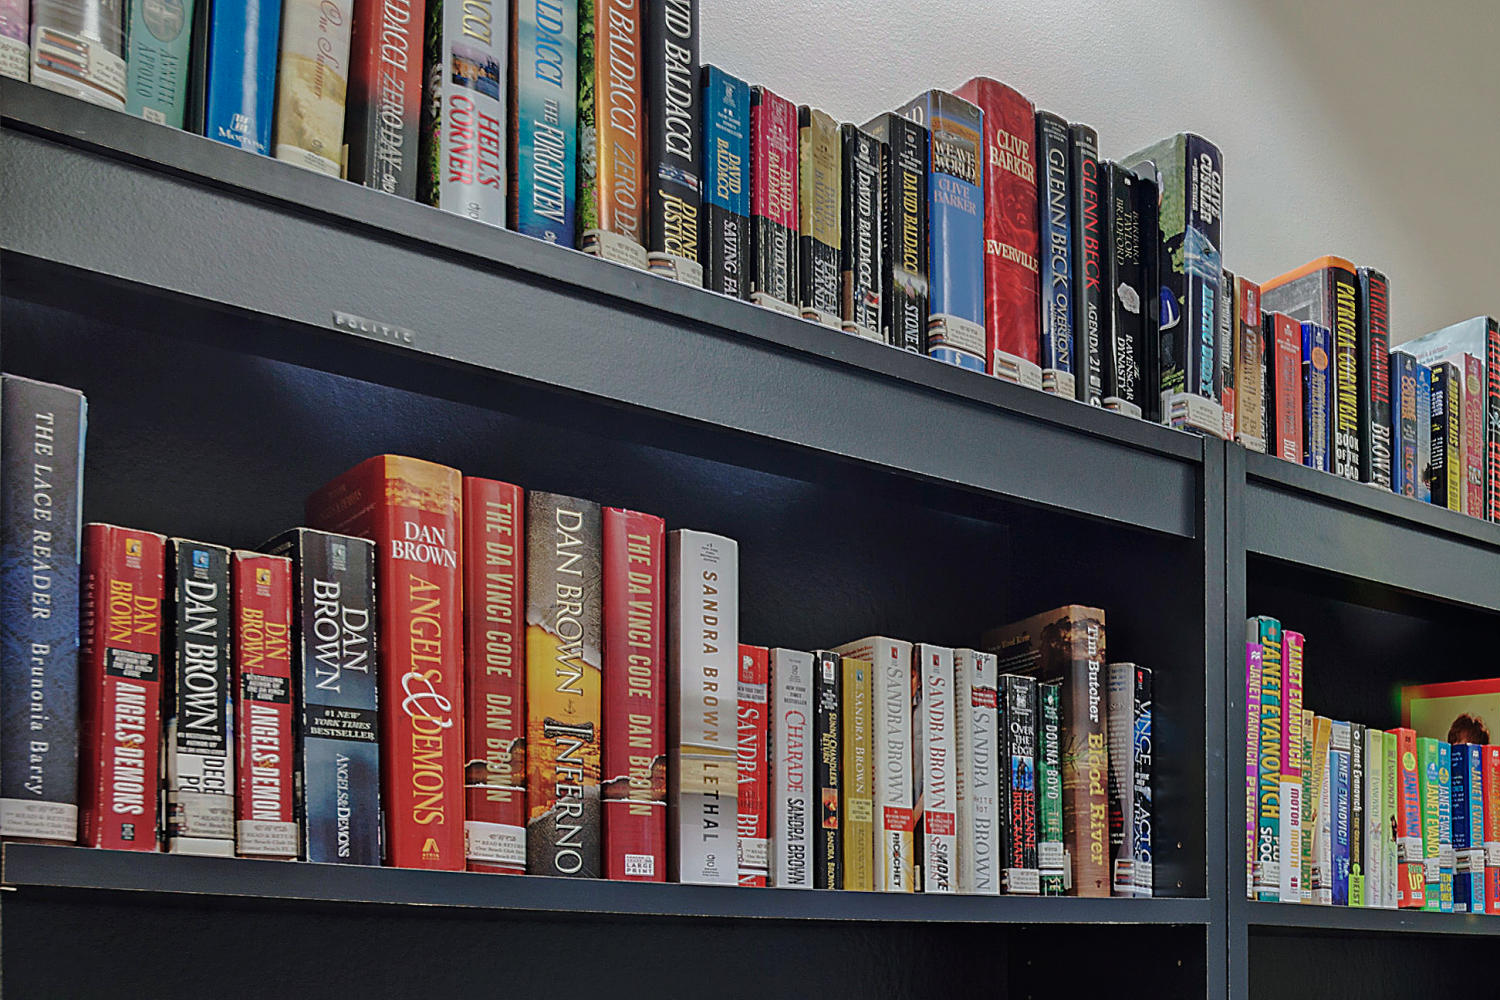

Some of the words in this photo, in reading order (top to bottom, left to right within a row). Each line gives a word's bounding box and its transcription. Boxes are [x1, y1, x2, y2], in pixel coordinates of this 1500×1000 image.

[608, 21, 636, 139] BALDACCI
[664, 39, 692, 161] BALDACCI
[448, 95, 474, 185] CORNER
[477, 111, 500, 190] HELL'S
[717, 138, 729, 200] BALDACCI
[989, 146, 1035, 184] BARKER
[996, 128, 1030, 157] CLIVE
[533, 120, 565, 225] FORGOTTEN
[613, 144, 637, 208] ZERO
[1049, 150, 1066, 228] GLENN
[1081, 159, 1100, 232] GLENN
[858, 220, 872, 294] BALDACCI
[986, 239, 1039, 275] EVERVILLE
[1051, 231, 1068, 289] BECK
[1084, 233, 1101, 291] BECK
[1337, 281, 1356, 352] PATRICIA
[1370, 278, 1387, 337] PATRICIA
[1337, 353, 1358, 432] CORNWELL
[34, 412, 54, 458] THE
[1336, 432, 1359, 453] BOOK
[32, 465, 53, 521] LACE
[485, 501, 512, 536] THE
[391, 540, 457, 569] BROWN
[404, 521, 446, 546] DAN
[486, 543, 513, 571] DA
[555, 508, 584, 577] DAN
[627, 533, 652, 567] THE
[31, 527, 52, 621] READER
[486, 572, 512, 627] VINCI
[627, 571, 652, 598] DA
[110, 579, 132, 643] BROWN
[132, 595, 158, 637] DAN
[184, 579, 219, 634] DAN
[242, 607, 265, 670] BROWN
[313, 578, 342, 694] BROWN
[410, 574, 441, 685] ANGELS
[627, 599, 652, 653] VINCI
[702, 570, 718, 655] SANDRA
[265, 620, 287, 660] DAN
[341, 607, 369, 674] DAN
[486, 629, 512, 678] CODE
[555, 583, 584, 697] BROWN
[1262, 636, 1281, 700] JANET
[30, 643, 50, 732] Brunonia
[184, 640, 220, 732] BROWN
[627, 654, 653, 700] CODE
[702, 667, 719, 742] BROWN
[887, 667, 904, 735] SANDRA
[929, 676, 946, 742] SANDRA
[1087, 660, 1100, 723] Butcher
[114, 681, 146, 746] ANGELS
[250, 704, 280, 768] ANGELS
[486, 693, 512, 732] DAN
[628, 713, 653, 751] DAN
[1289, 689, 1302, 769] EVANOVICH
[25, 739, 50, 796] Barry
[411, 715, 444, 826] DEMONS
[486, 738, 512, 803] BROWN
[737, 707, 760, 785] SANDRA
[887, 738, 904, 805] BROWN
[929, 744, 947, 811] BROWN
[973, 709, 991, 790] SANDRA
[1087, 732, 1105, 796] Blood
[1261, 704, 1281, 819] EVANOVICH
[113, 745, 145, 817] DEMONS
[544, 717, 594, 875] INFERNO
[628, 755, 653, 817] BROWN
[703, 764, 719, 842] LETHAL
[974, 817, 992, 891] BROWN
[1090, 804, 1103, 865] River
